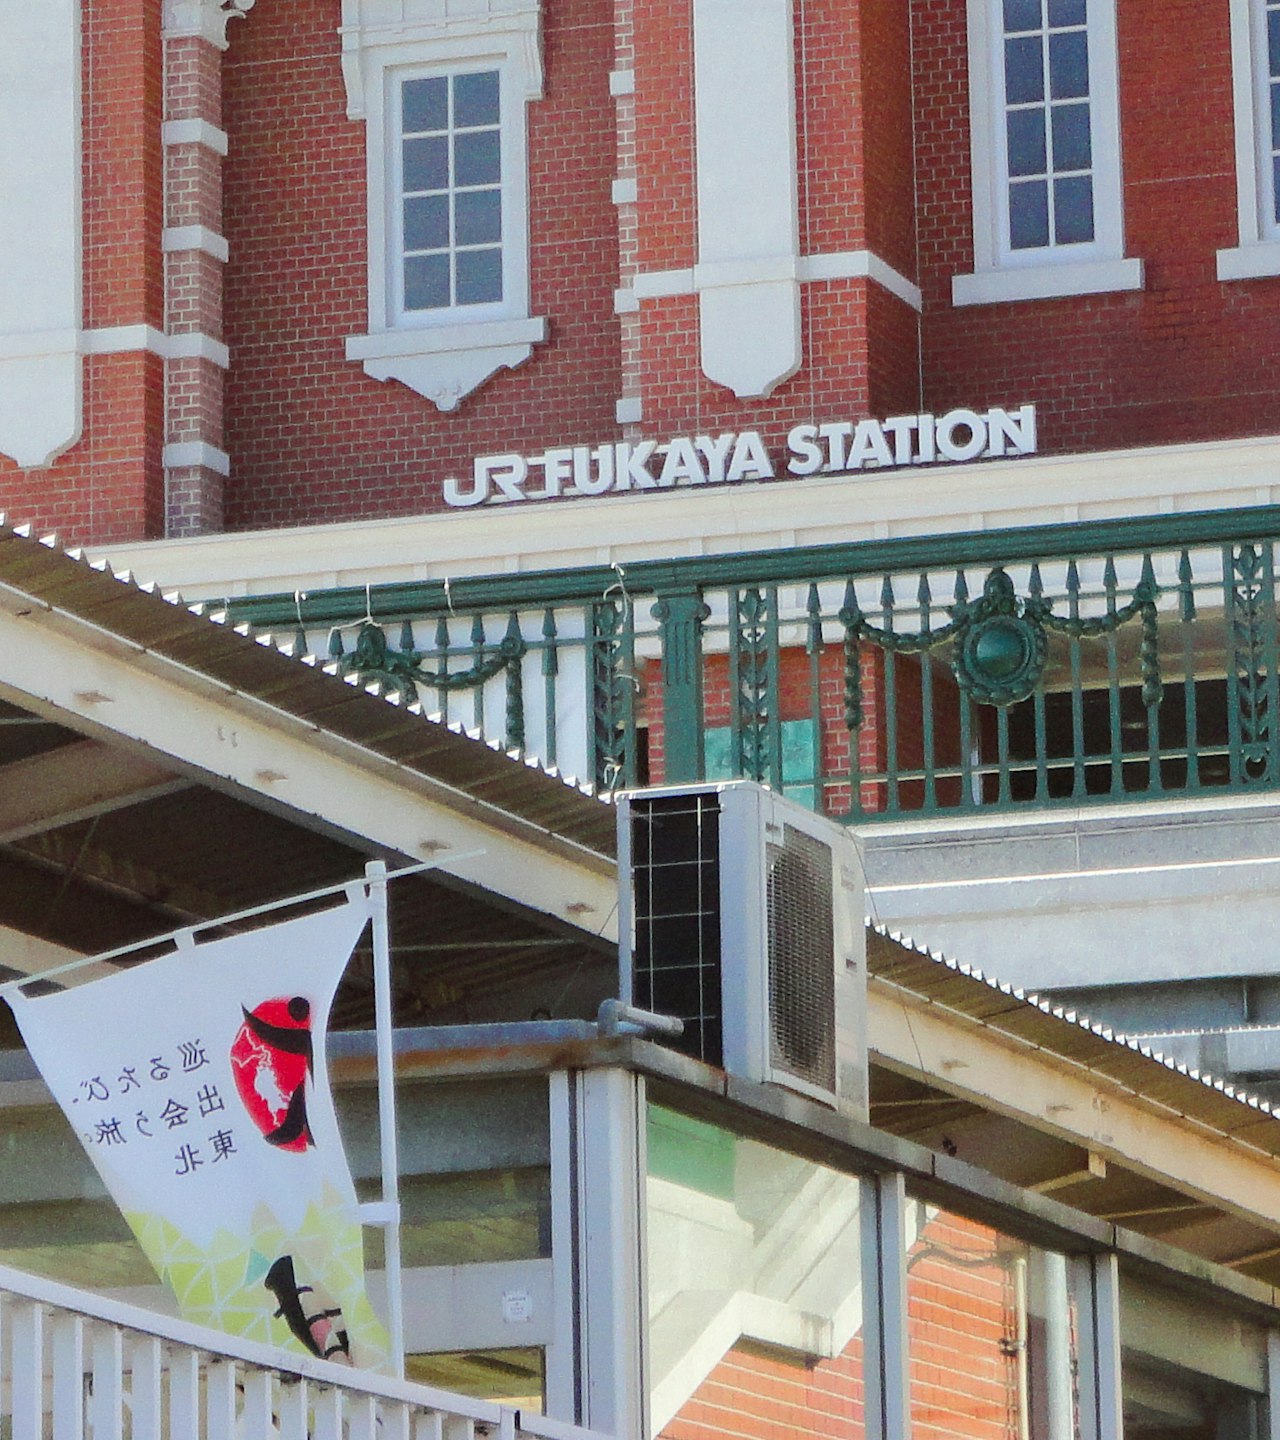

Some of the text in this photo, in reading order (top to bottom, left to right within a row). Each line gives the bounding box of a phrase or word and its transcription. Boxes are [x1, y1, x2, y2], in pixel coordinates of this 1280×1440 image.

[443, 405, 1037, 507] JR FUKAYA STATION
